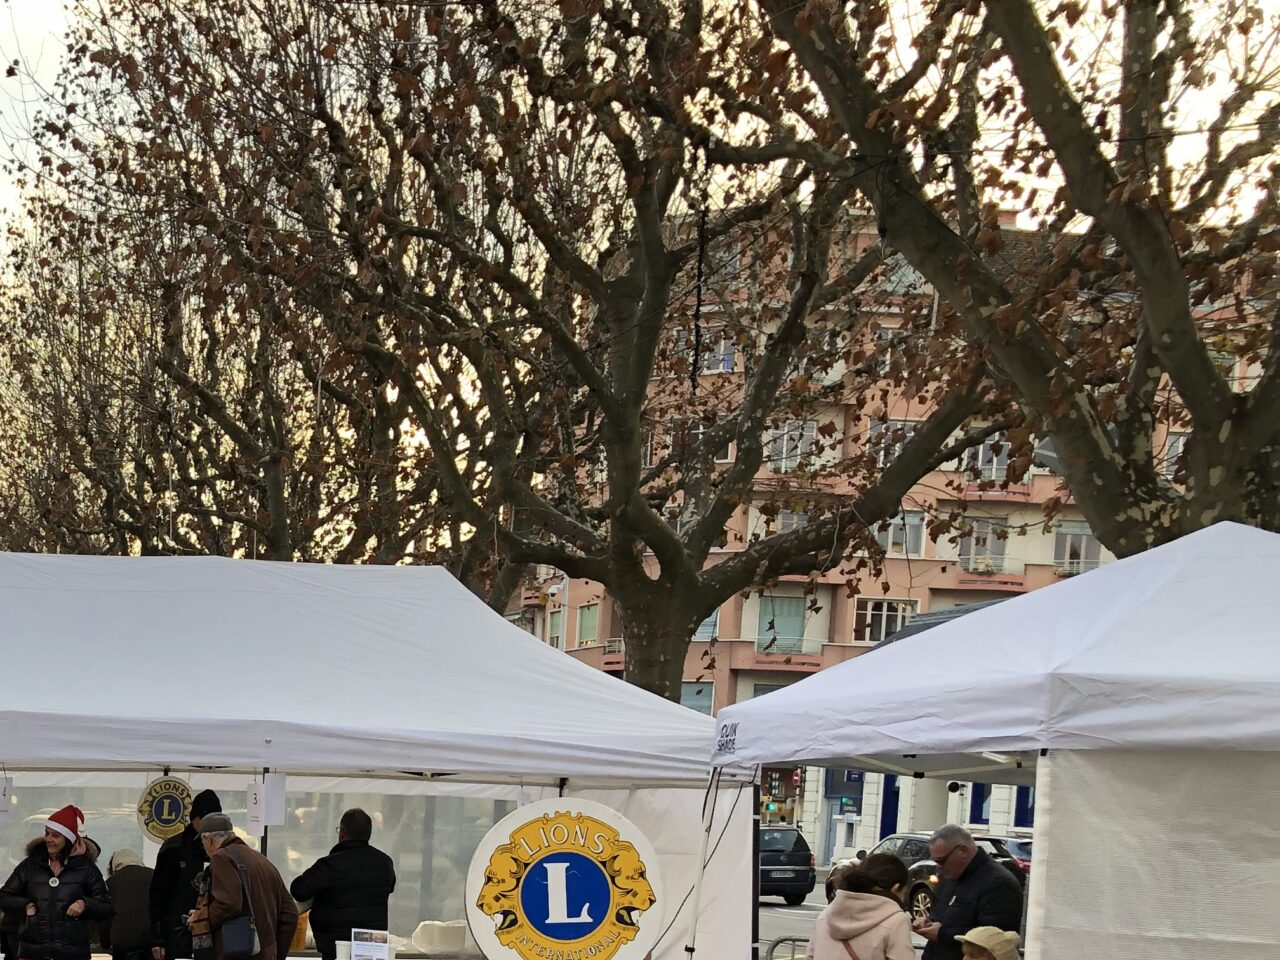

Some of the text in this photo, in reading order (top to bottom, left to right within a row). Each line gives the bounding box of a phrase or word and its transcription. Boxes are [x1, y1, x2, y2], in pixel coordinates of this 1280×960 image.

[154, 783, 186, 796] LIONS
[253, 792, 258, 805] 3
[161, 799, 176, 819] L
[520, 823, 609, 856] LIONS
[543, 863, 593, 923] L
[516, 929, 621, 960] INTERNATIONAL
